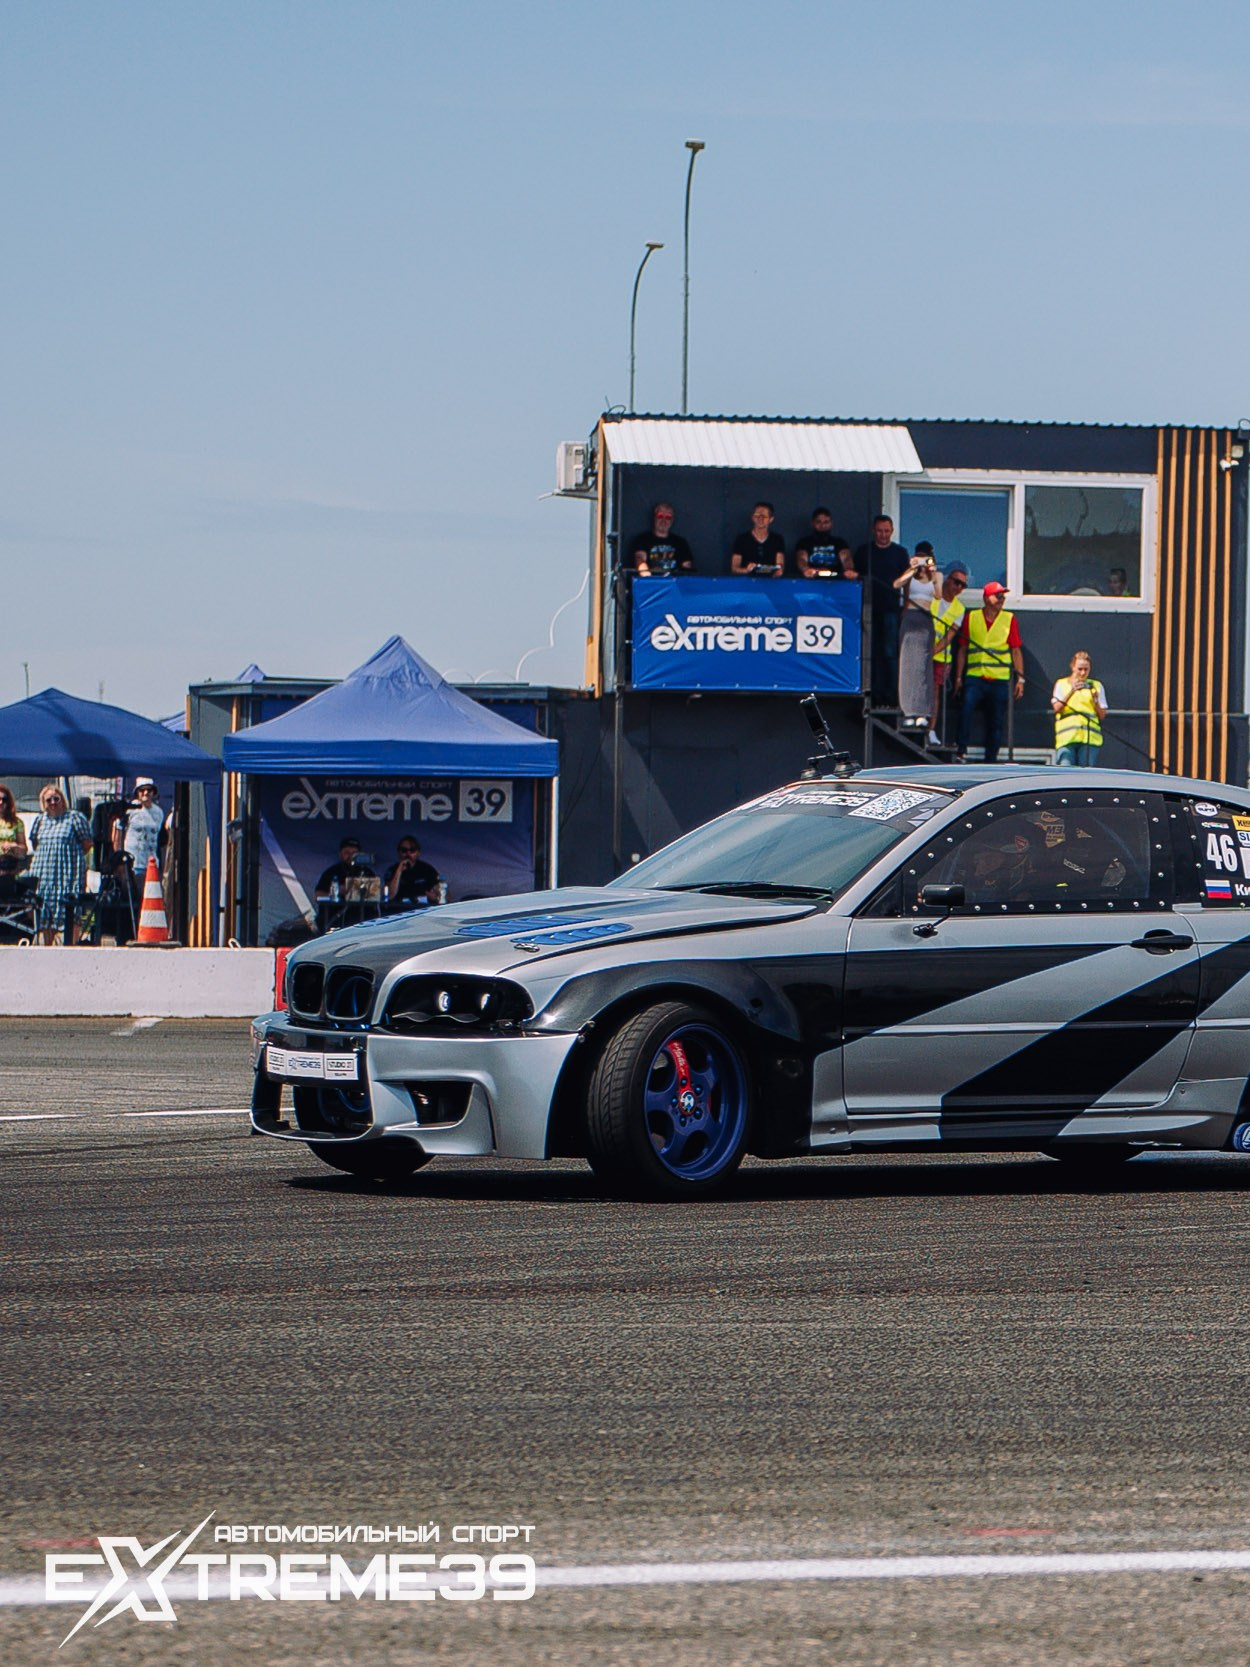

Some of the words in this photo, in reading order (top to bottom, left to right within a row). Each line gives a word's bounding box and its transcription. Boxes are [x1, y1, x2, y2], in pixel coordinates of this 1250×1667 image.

[803, 624, 836, 648] 39
[465, 788, 506, 817] 39
[1206, 833, 1238, 872] 46
